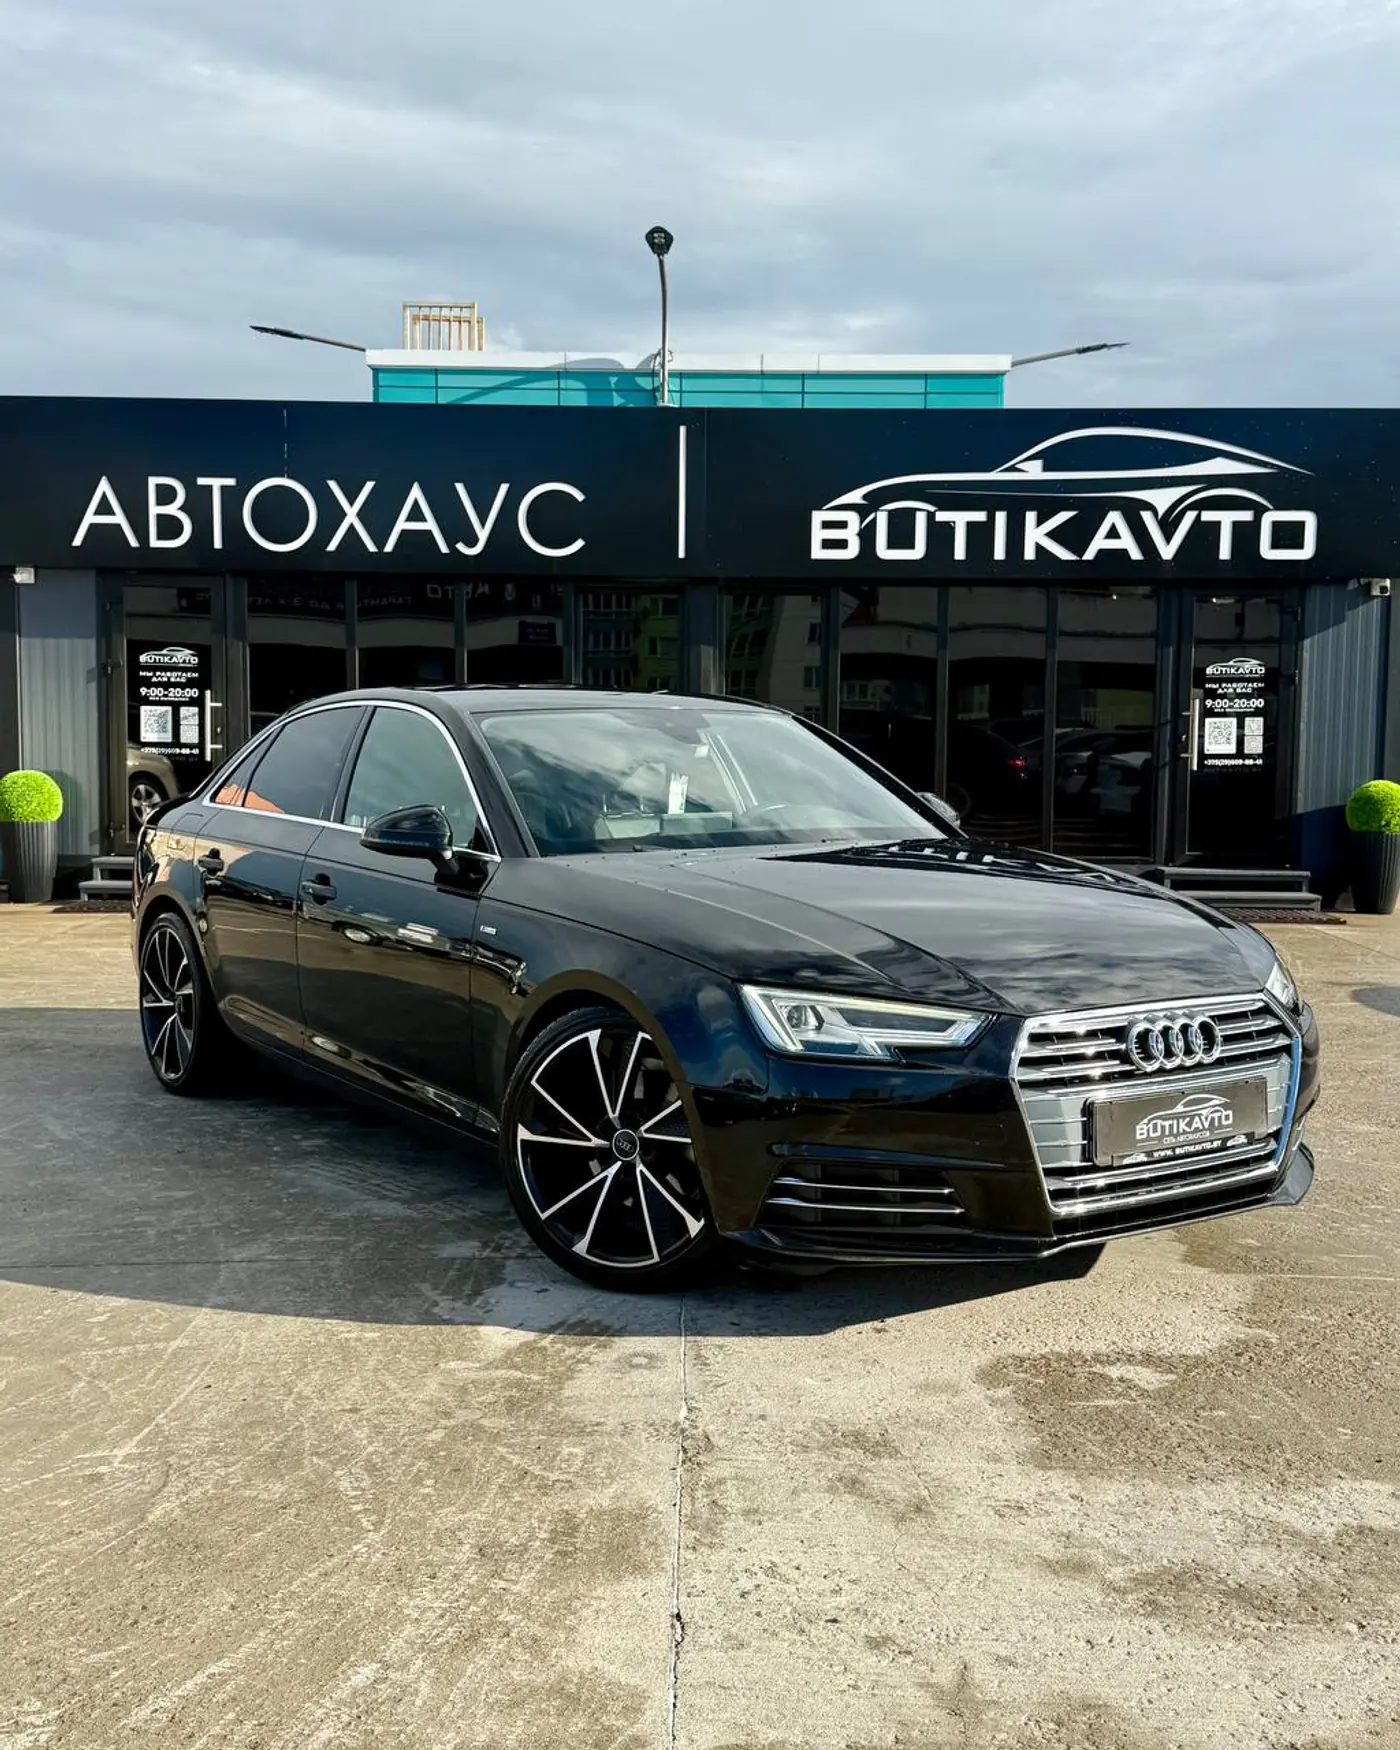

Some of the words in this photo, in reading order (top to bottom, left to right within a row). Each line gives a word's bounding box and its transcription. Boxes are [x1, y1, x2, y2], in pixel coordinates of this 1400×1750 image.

[71, 475, 587, 557] АВТОХАУС
[810, 509, 1318, 561] BUTIKAVTO
[140, 655, 198, 663] BUTIKAVTO
[1205, 666, 1265, 674] BUTIKAVTO
[140, 687, 199, 698] 9:00-20:00
[1205, 698, 1264, 708] 9:00-20:00
[1136, 1110, 1233, 1140] BUTIKAVTO
